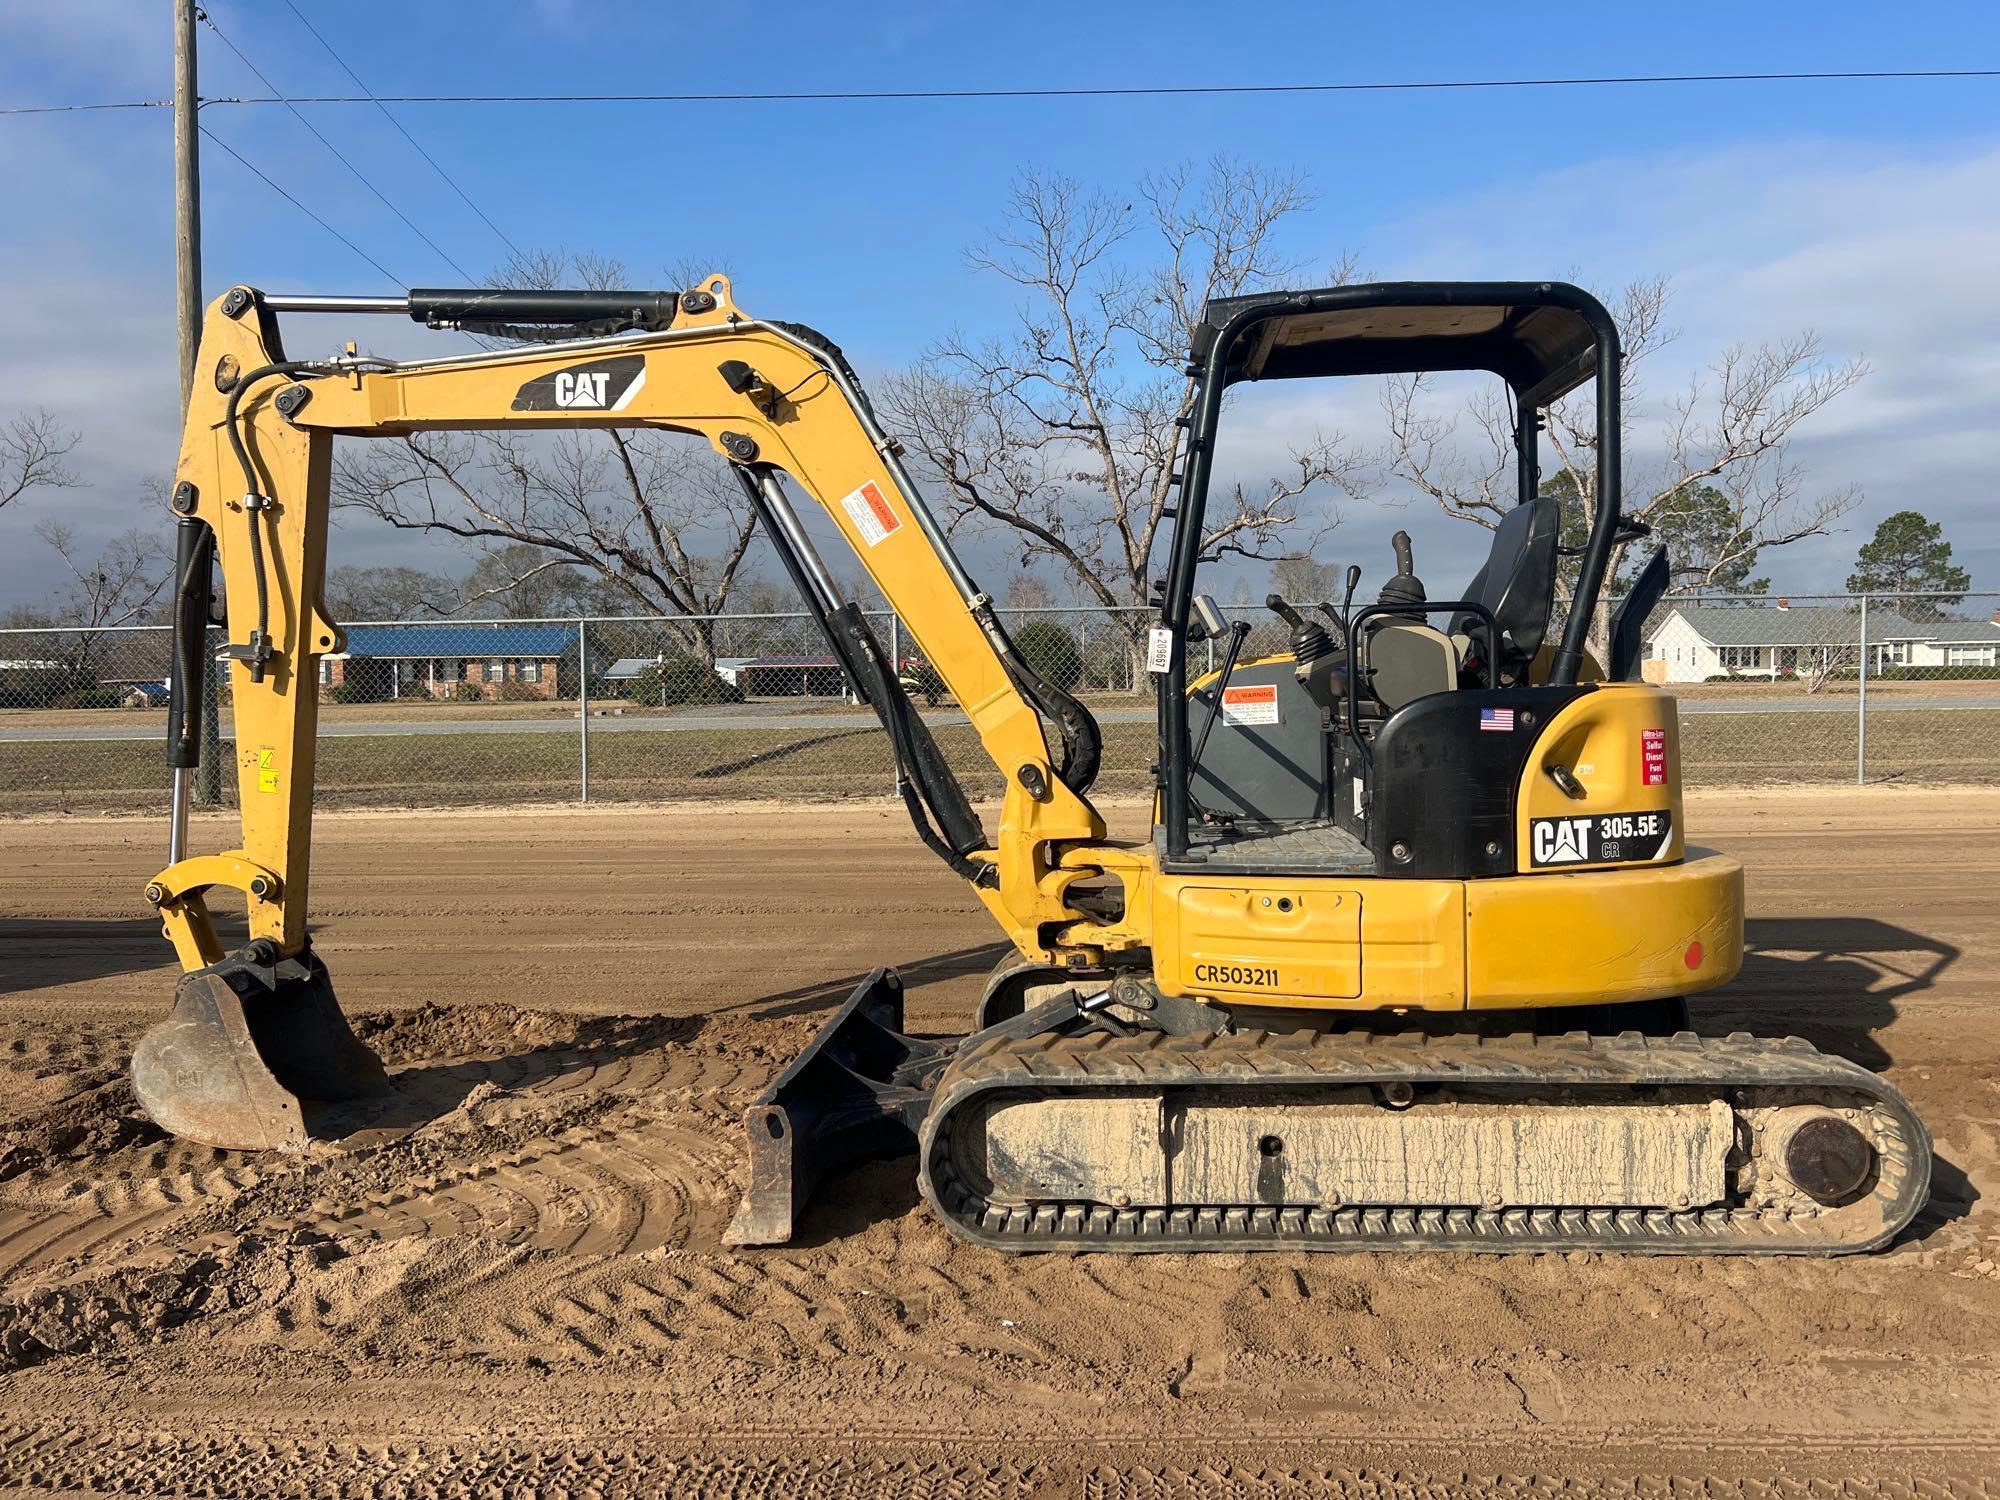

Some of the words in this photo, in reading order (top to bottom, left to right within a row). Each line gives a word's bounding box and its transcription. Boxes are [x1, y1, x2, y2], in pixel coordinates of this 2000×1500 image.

[555, 372, 610, 407] CAT
[874, 501, 895, 529] WARNING
[1155, 639, 1168, 668] 209667
[1642, 730, 1664, 738] Ultra-Low
[1646, 741, 1663, 750] Sulfur
[1645, 752, 1664, 762] Diesel
[1649, 763, 1662, 772] Fuel
[1649, 774, 1663, 782] ONLY
[1534, 819, 1592, 862] CAT
[1601, 841, 1620, 859] CR
[1195, 964, 1278, 986] CR503211
